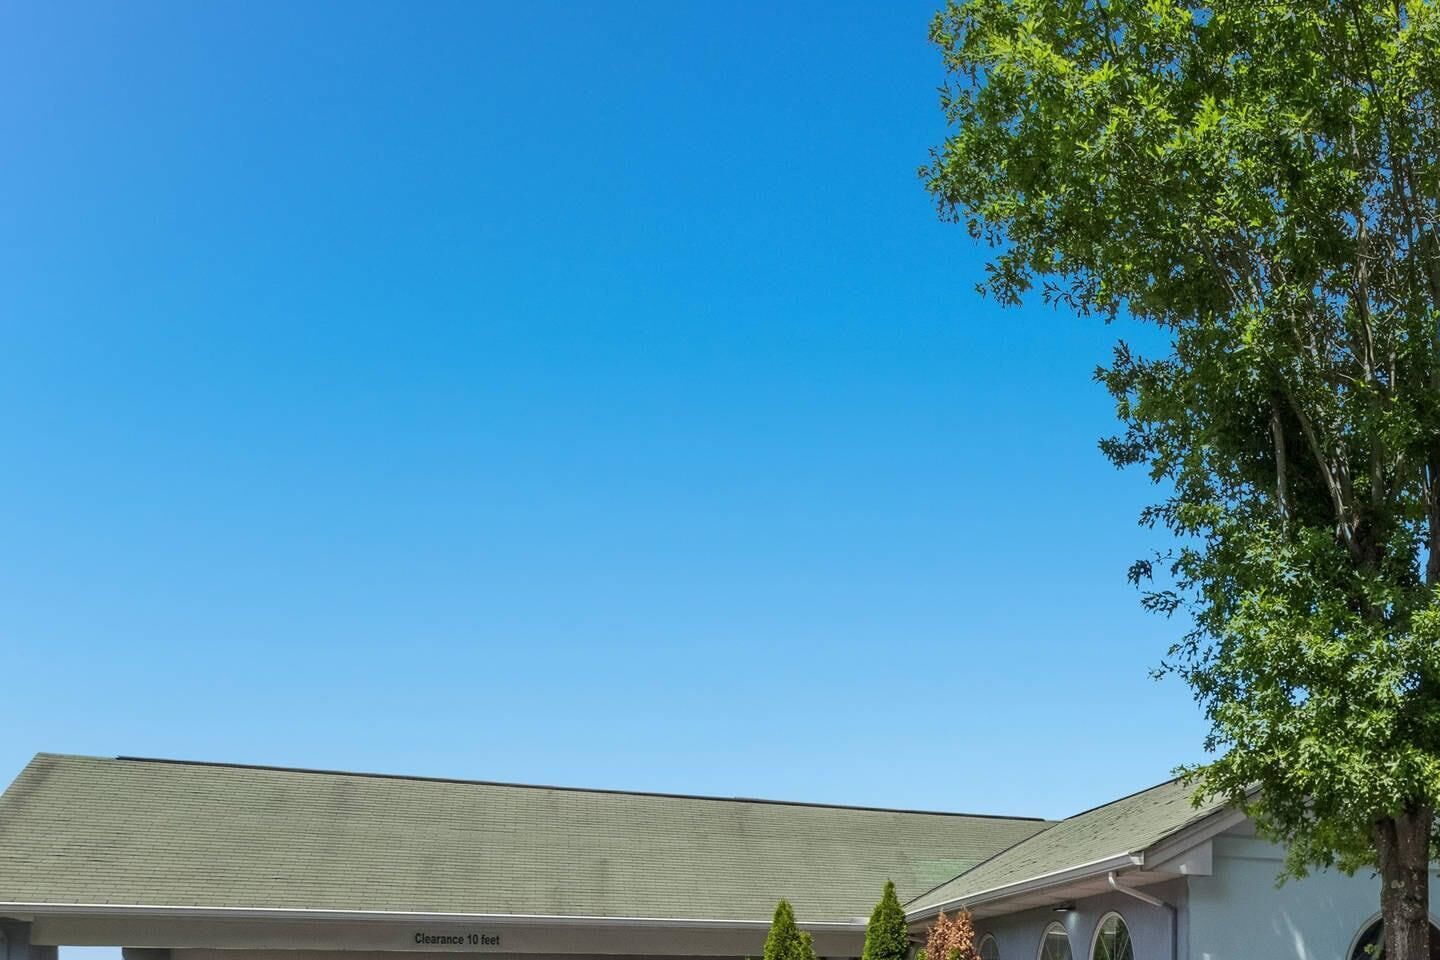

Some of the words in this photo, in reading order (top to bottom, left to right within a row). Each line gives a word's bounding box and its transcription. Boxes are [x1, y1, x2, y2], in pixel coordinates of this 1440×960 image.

[415, 933, 464, 944] Clearance
[467, 934, 478, 945] 10
[481, 934, 500, 945] feet
